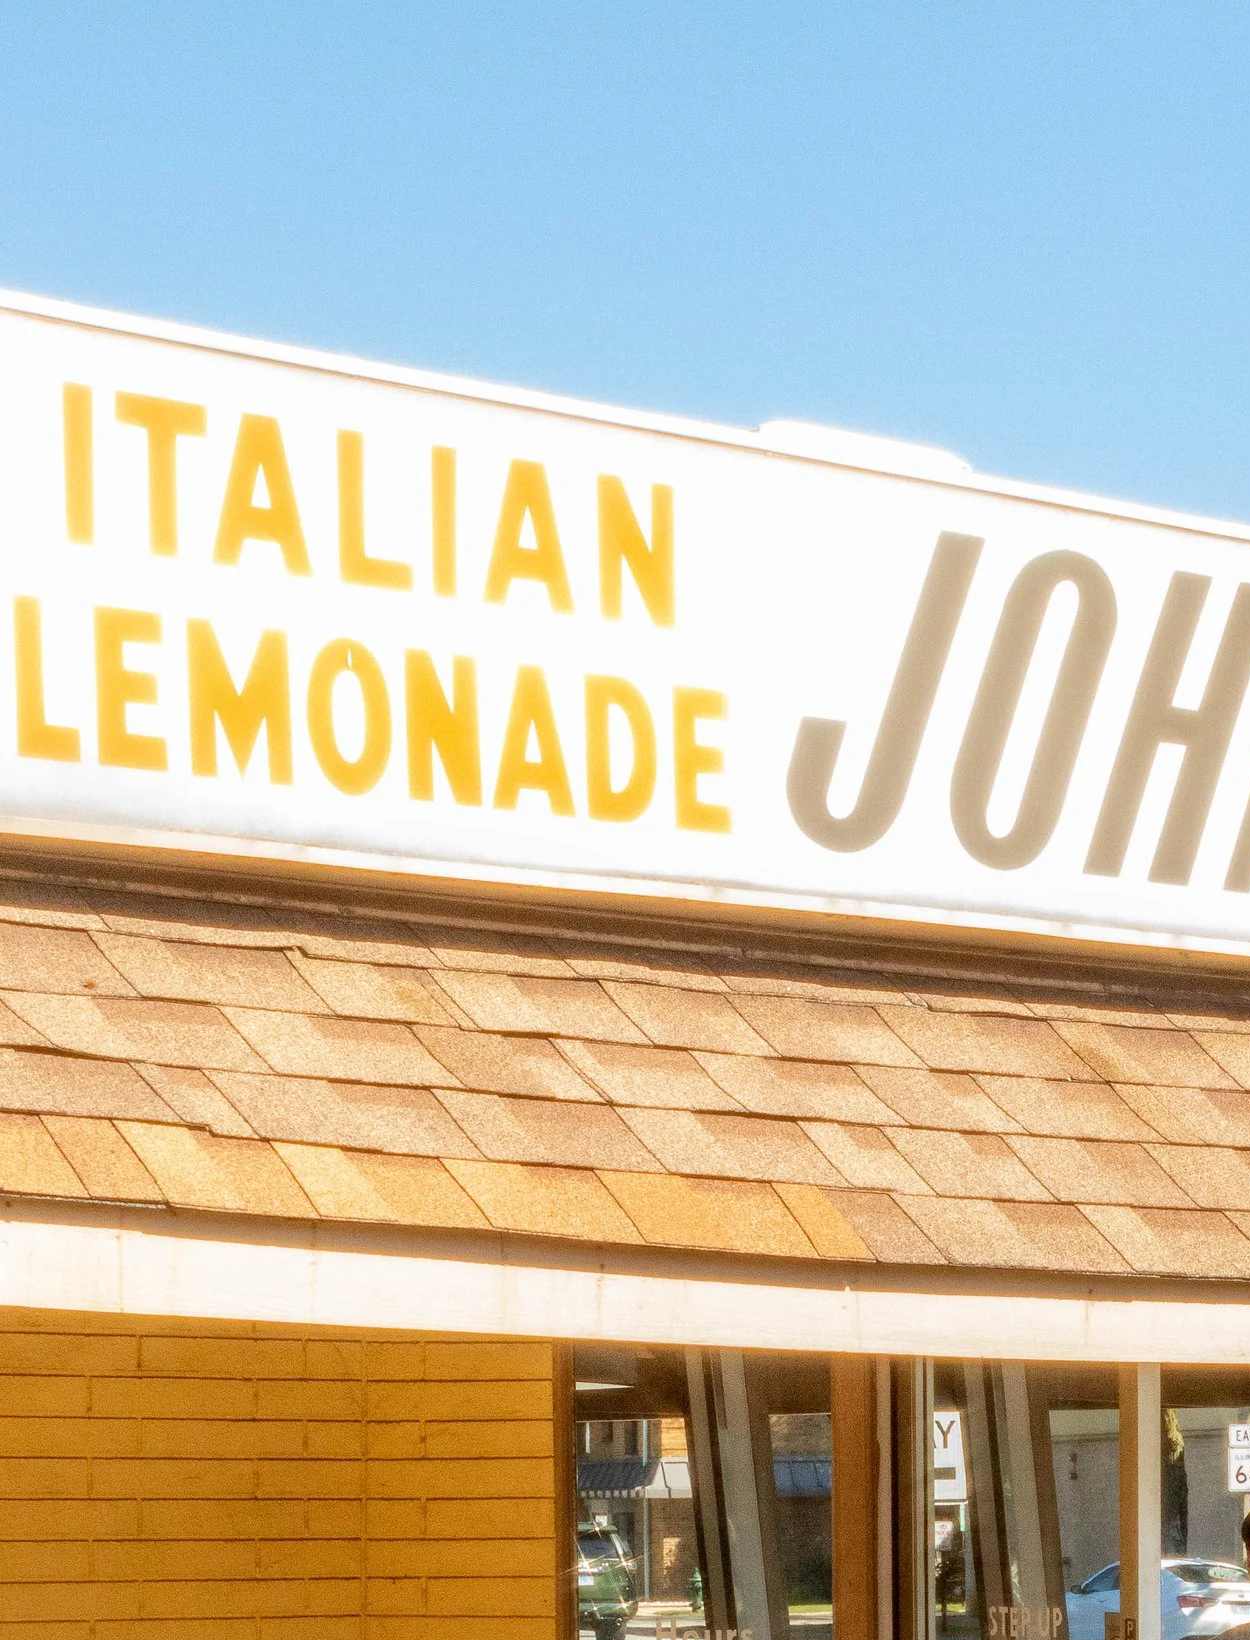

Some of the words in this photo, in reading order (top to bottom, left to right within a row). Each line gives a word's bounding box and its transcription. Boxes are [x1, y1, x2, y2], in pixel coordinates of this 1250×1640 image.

[63, 381, 676, 629] ITALIAN
[14, 594, 733, 834] LEMONADE
[934, 1420, 956, 1449] Y
[988, 1606, 1031, 1637] STEP
[1040, 1607, 1063, 1638] UP
